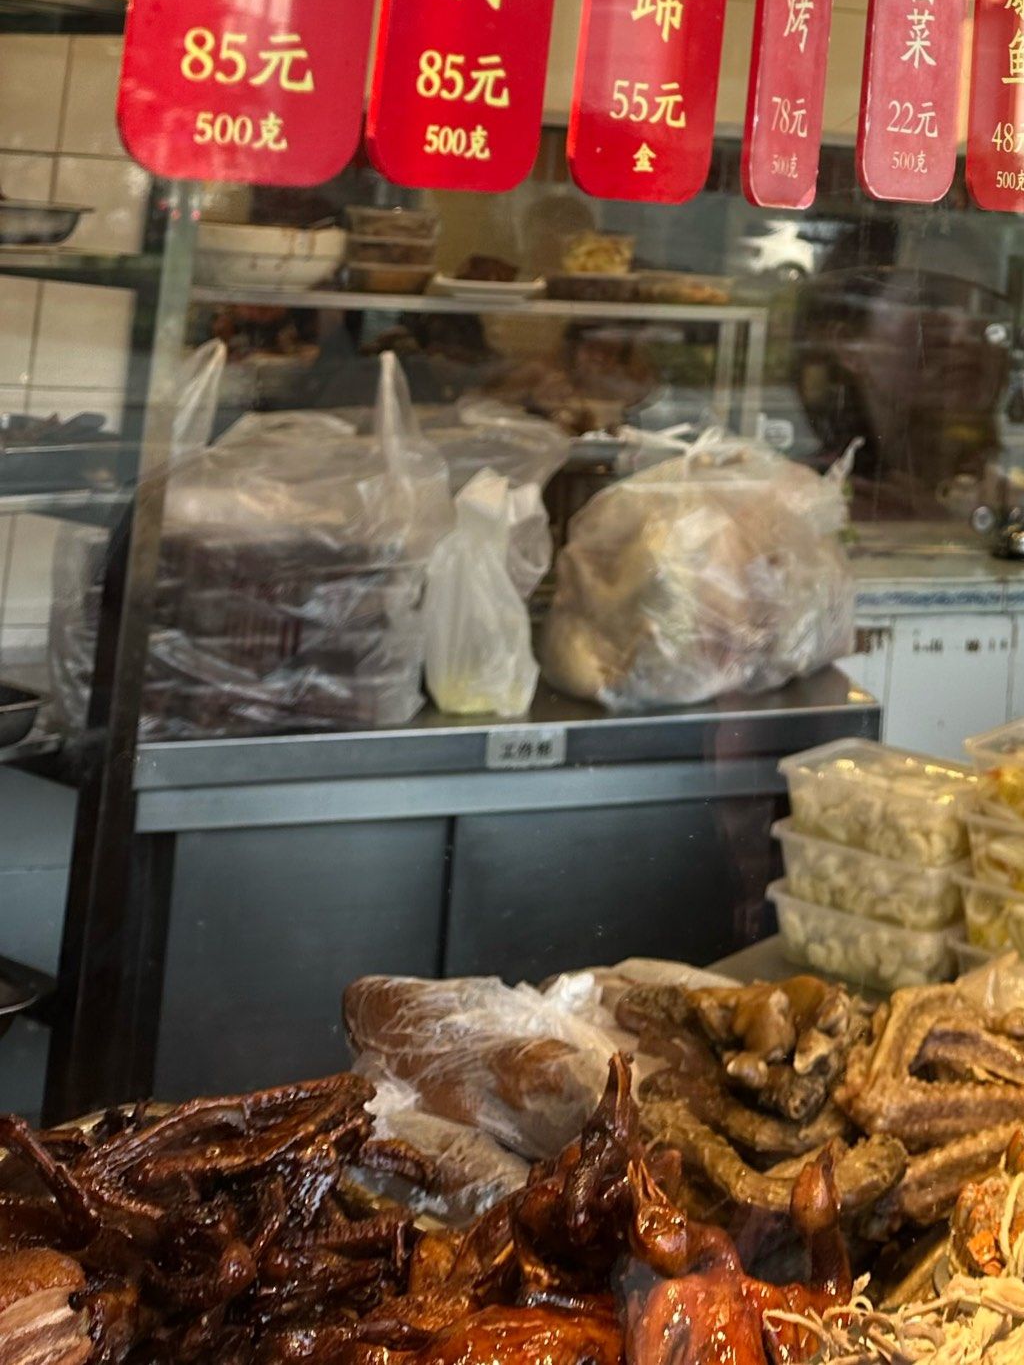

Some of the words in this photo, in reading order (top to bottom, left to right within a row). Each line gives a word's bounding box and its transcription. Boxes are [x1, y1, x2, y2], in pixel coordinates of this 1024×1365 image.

[179, 27, 315, 95] 85元
[415, 48, 510, 110] 85元
[608, 79, 687, 129] 55元
[770, 96, 809, 138] 78元
[886, 99, 939, 139] 22元
[193, 109, 289, 153] 500克
[422, 123, 491, 162] 500克
[631, 142, 657, 175] 盒
[890, 149, 929, 176] 500克
